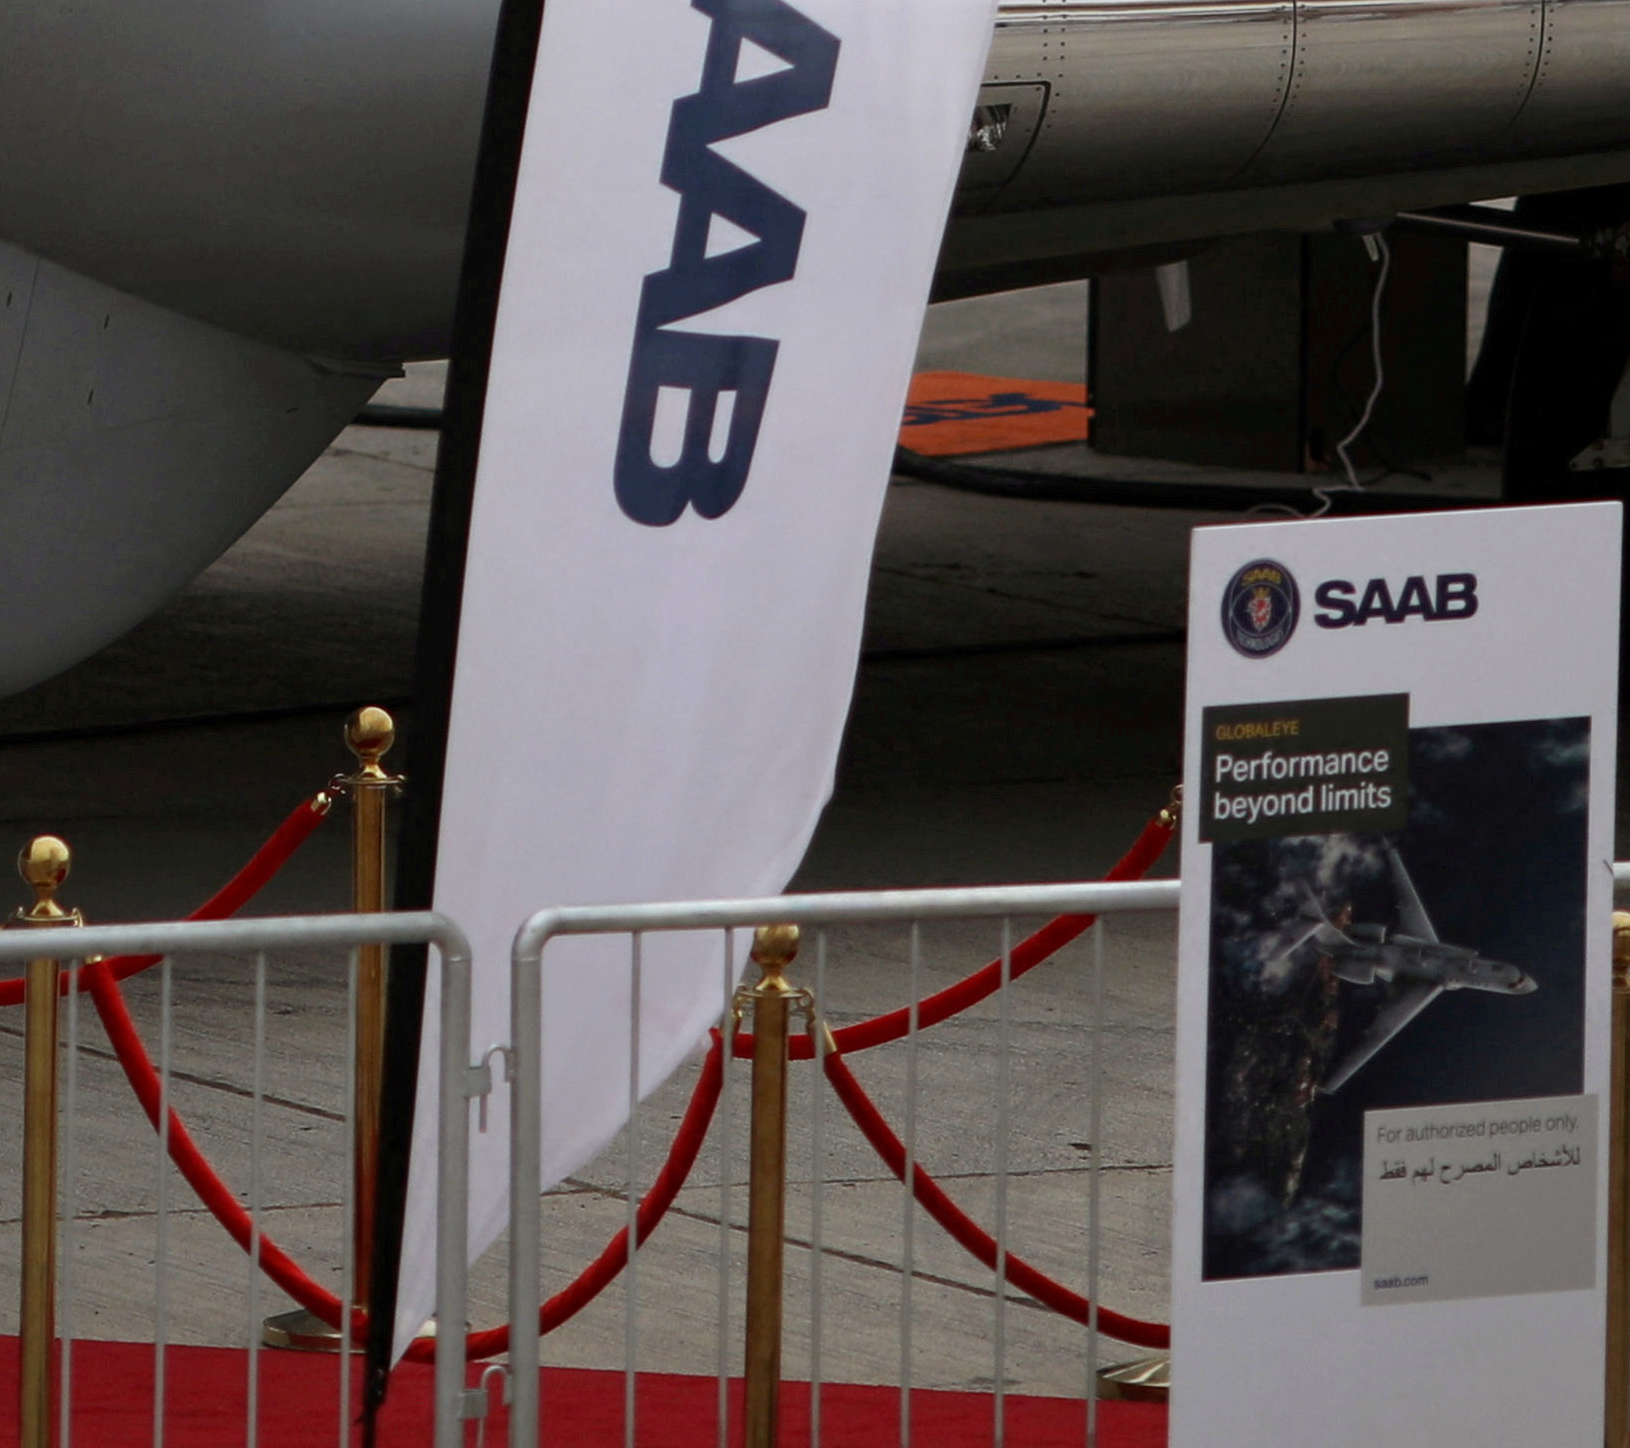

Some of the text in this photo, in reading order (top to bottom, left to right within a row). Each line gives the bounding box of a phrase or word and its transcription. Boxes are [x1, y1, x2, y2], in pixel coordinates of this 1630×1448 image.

[1242, 567, 1282, 586] SAAB
[1313, 572, 1480, 630] SAAB
[1215, 720, 1300, 741] GLOBALEYE
[1215, 748, 1390, 784] Performance
[1213, 781, 1392, 825] beyond limits
[1376, 1113, 1580, 1144] For authorized people only.
[1379, 1159, 1408, 1181] فقط
[1411, 1157, 1435, 1185] لهم
